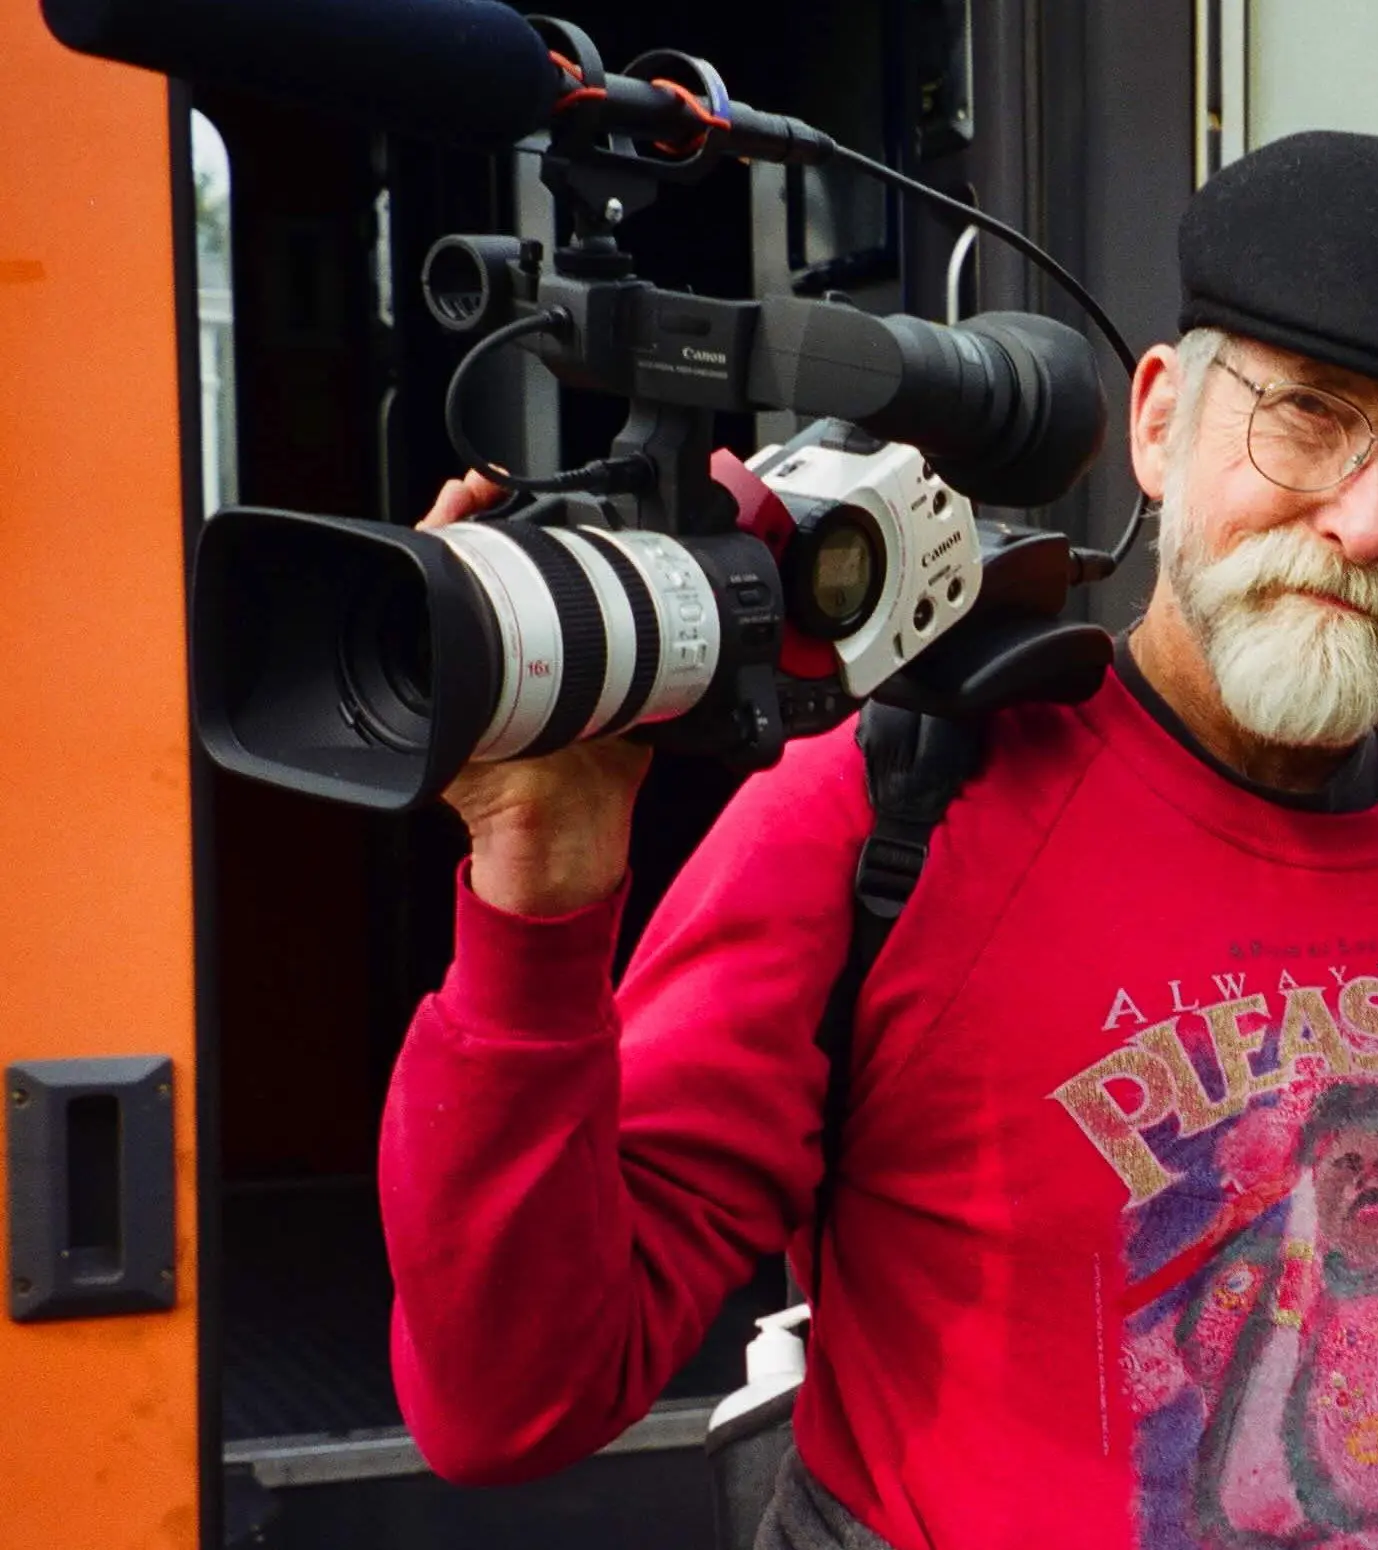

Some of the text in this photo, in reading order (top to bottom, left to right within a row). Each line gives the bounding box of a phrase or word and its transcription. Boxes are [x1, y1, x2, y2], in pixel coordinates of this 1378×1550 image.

[682, 347, 727, 364] Canon
[921, 530, 962, 568] Canon
[527, 660, 552, 679] 16x
